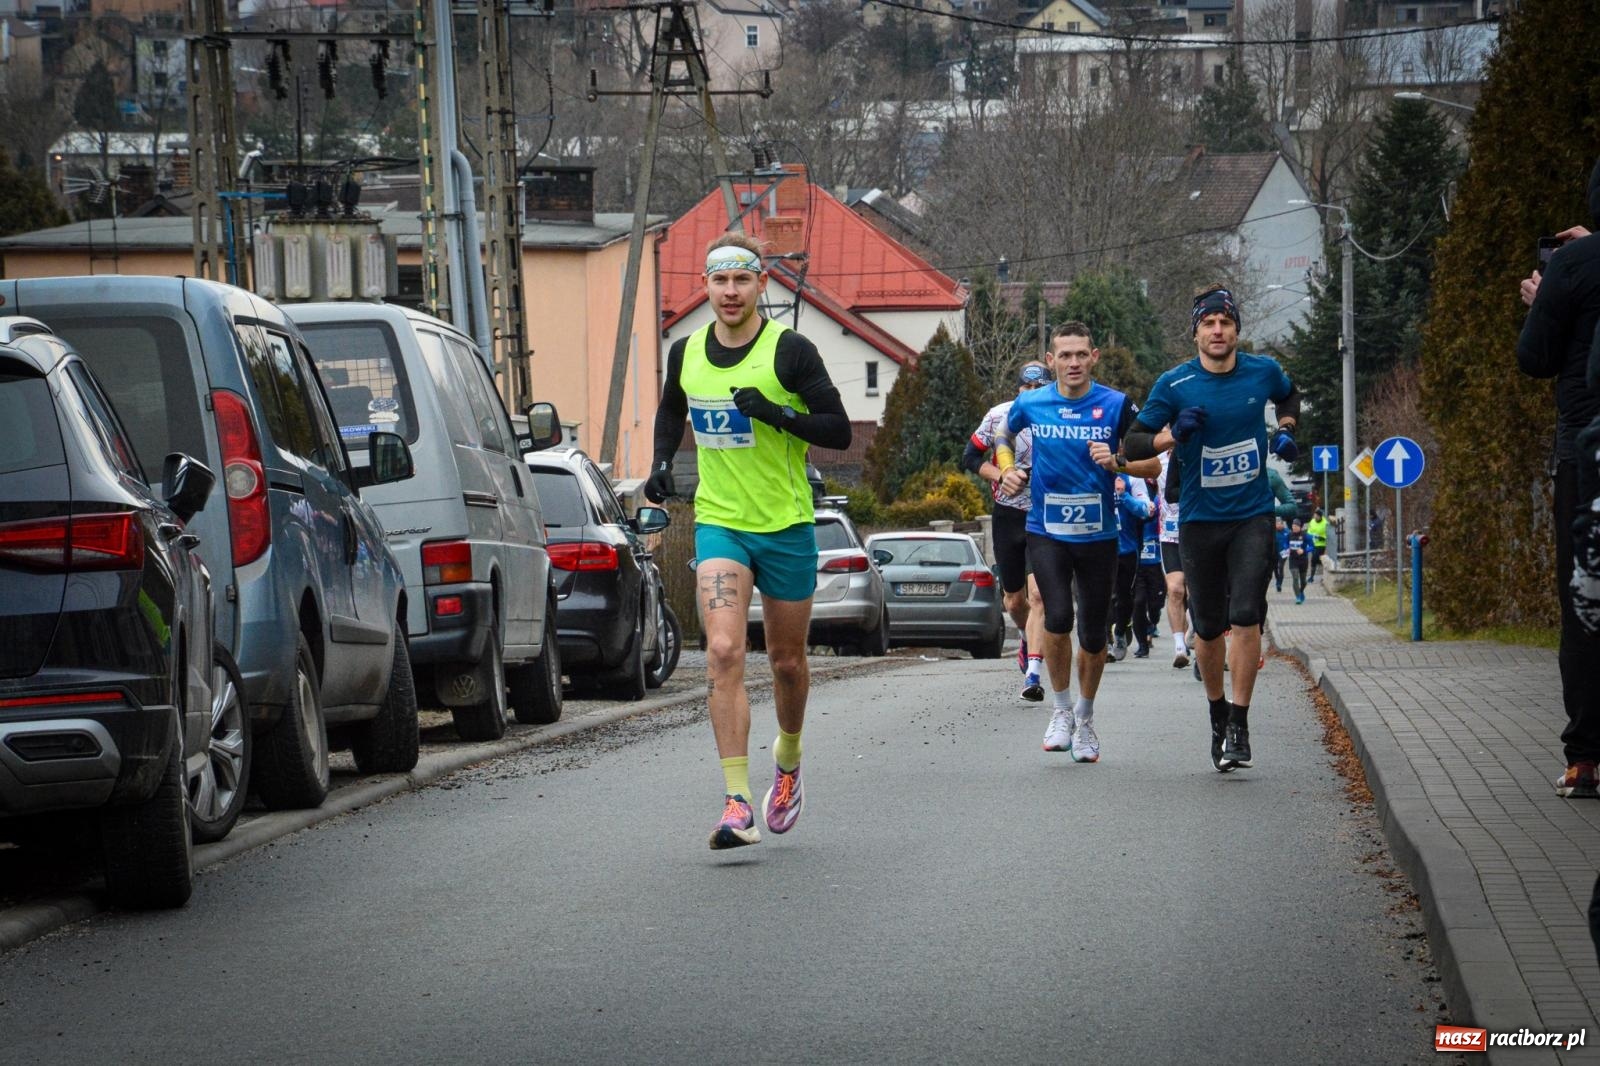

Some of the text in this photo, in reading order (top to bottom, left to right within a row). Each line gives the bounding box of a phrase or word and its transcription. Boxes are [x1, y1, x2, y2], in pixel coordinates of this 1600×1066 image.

[702, 410, 733, 433] 12
[1030, 423, 1113, 440] RUNNERS
[1211, 453, 1250, 476] 218
[1061, 505, 1086, 523] 92
